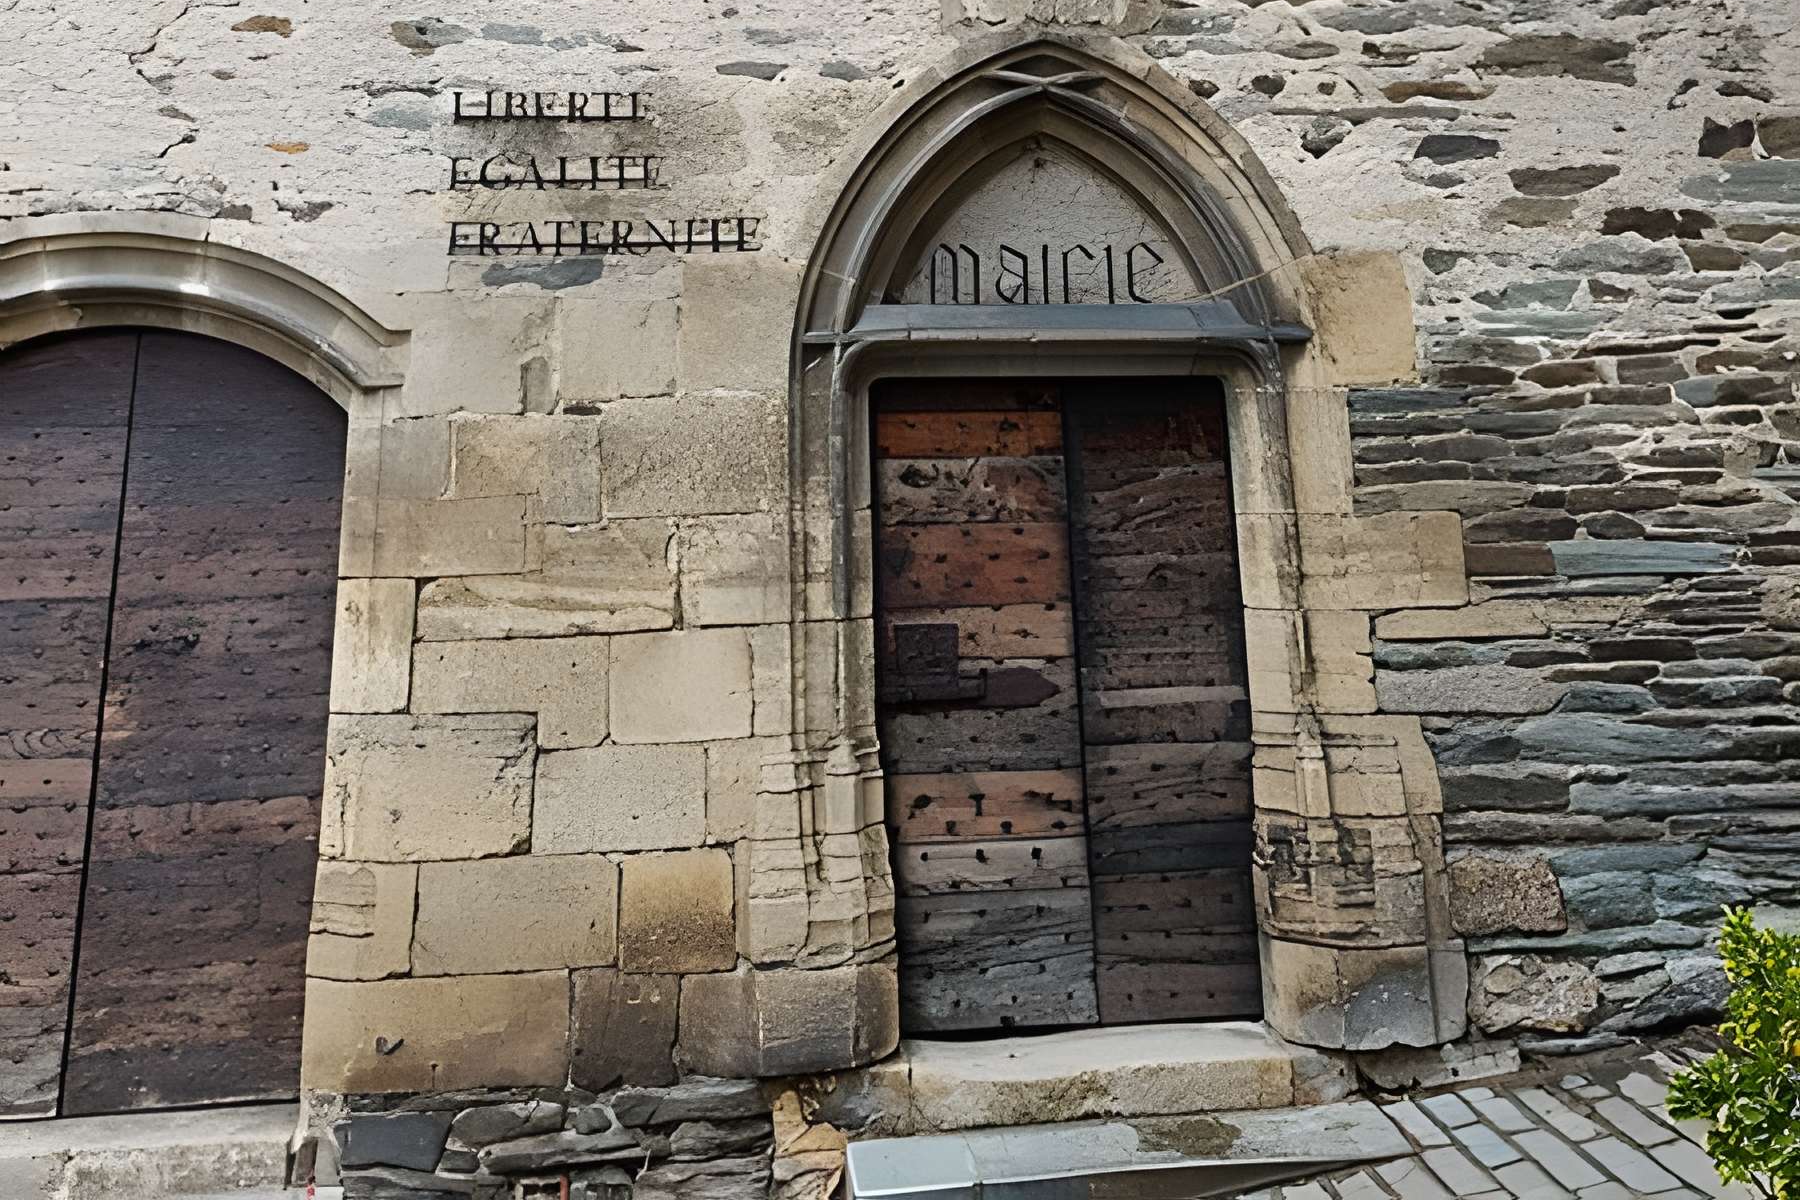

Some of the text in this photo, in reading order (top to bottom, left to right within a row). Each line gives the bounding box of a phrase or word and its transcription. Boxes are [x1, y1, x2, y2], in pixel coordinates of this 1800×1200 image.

[453, 91, 652, 123] LIBERTE
[446, 154, 665, 190] EGALITE
[447, 220, 764, 256] FRATERNITE
[930, 243, 1164, 304] mairie
